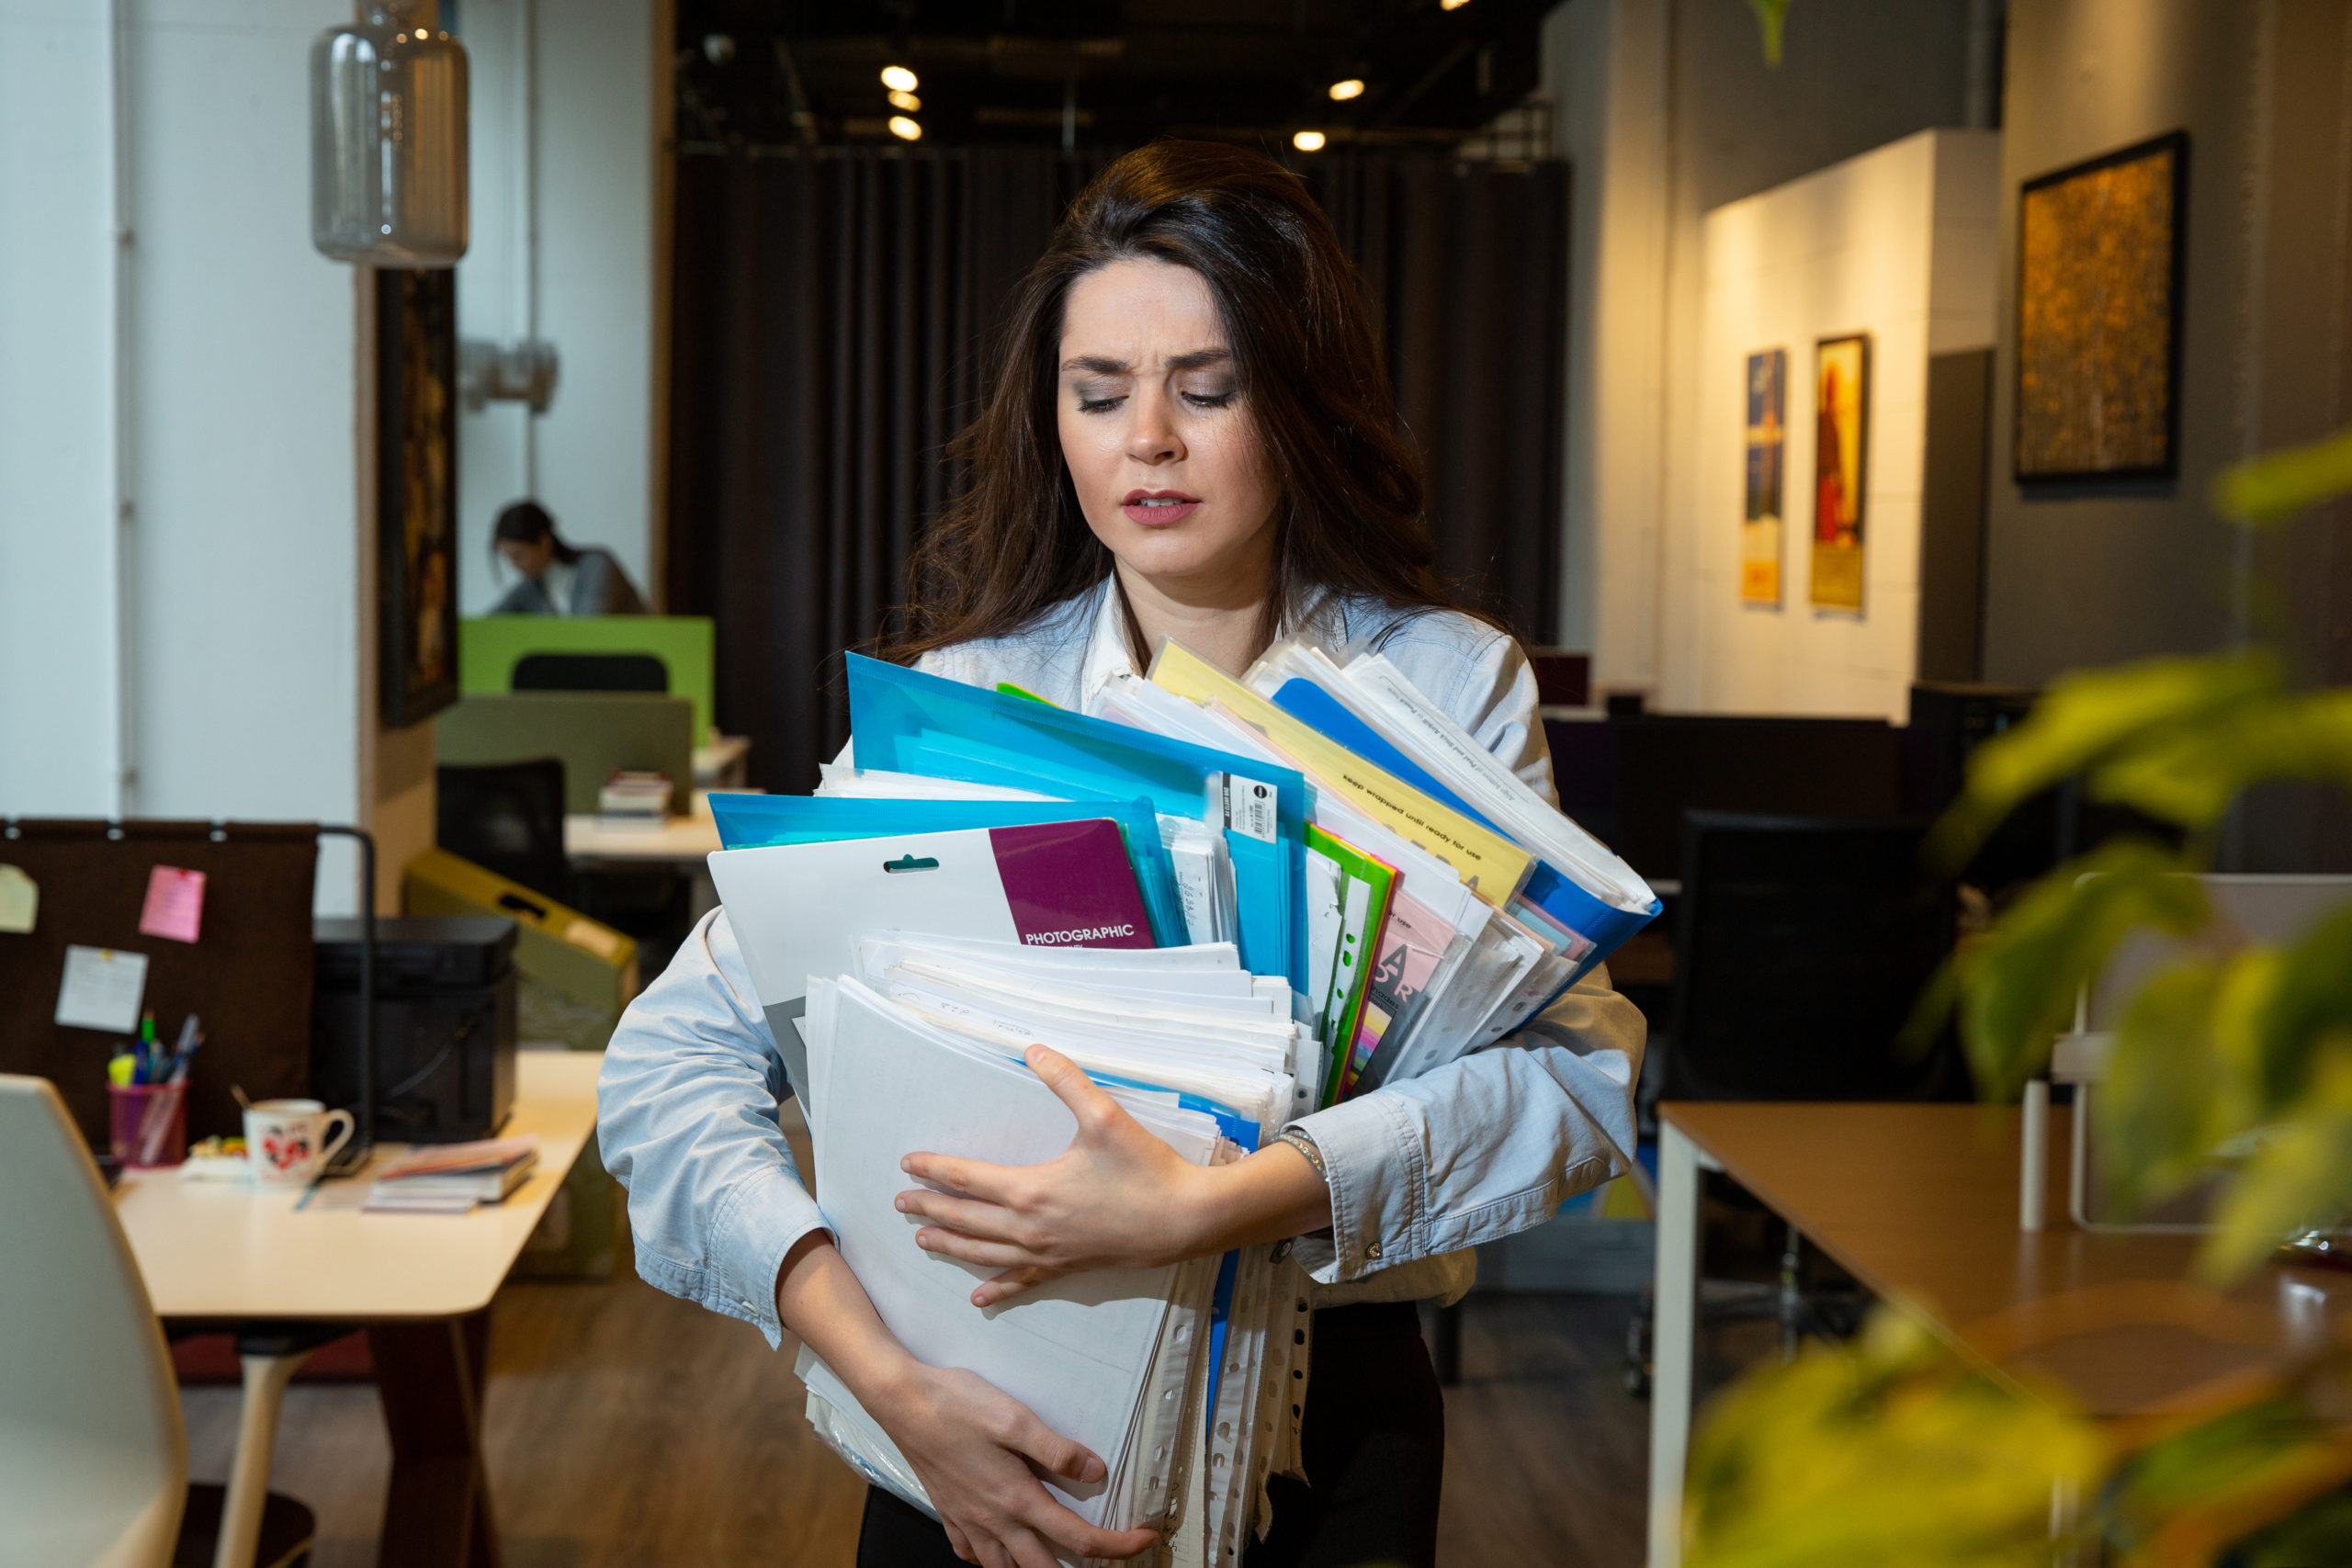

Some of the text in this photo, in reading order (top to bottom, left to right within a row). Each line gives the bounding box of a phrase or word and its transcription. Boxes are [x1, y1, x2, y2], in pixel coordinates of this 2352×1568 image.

[1342, 774, 1364, 790] keep
[1366, 789, 1404, 815] wrapped
[1406, 813, 1424, 827] until
[1425, 825, 1451, 843] ready
[1453, 840, 1464, 851] for
[1466, 849, 1482, 861] use
[1025, 924, 1135, 945] PHOTOGRAPHIC
[1397, 917, 1411, 929] use
[1370, 985, 1399, 1010] hades
